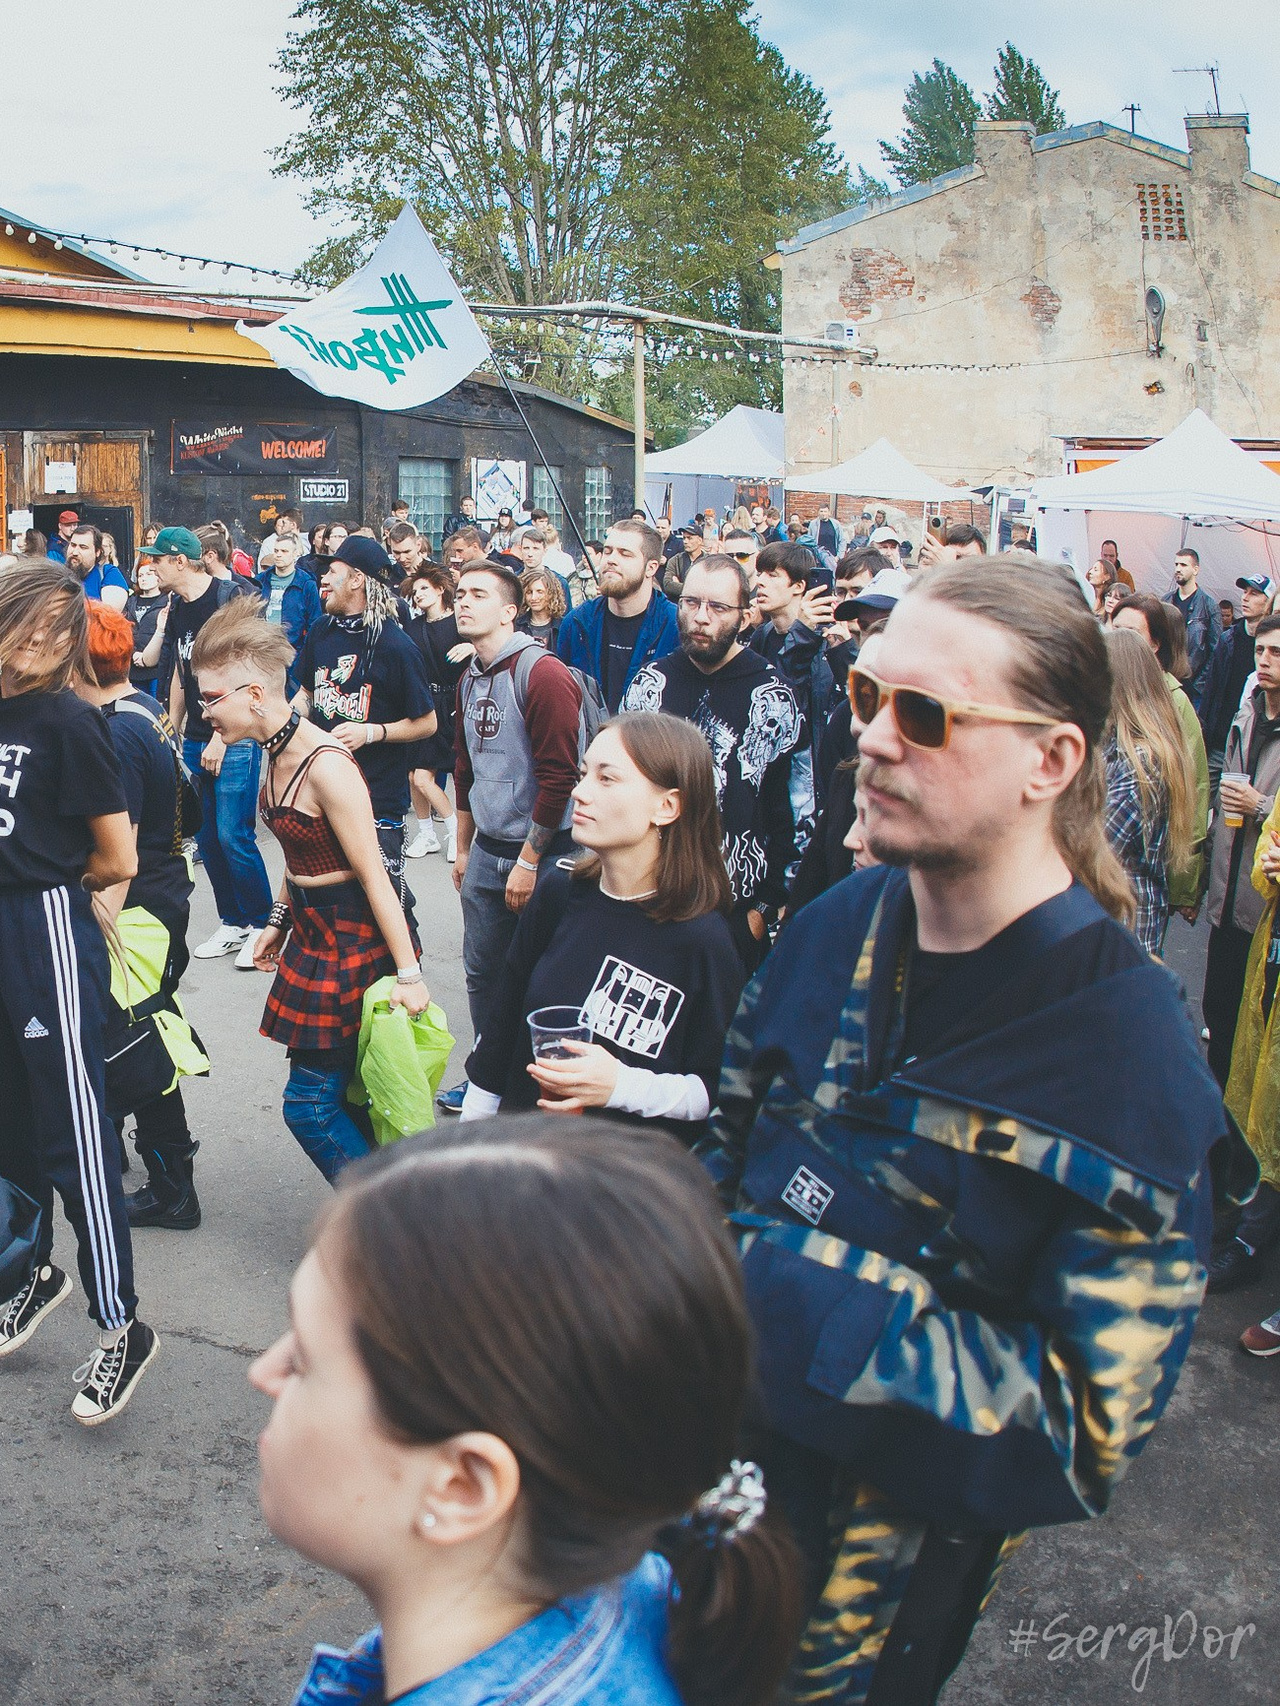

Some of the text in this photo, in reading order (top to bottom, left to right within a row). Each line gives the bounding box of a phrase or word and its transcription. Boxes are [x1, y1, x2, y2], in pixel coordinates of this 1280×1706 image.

[261, 439, 326, 460] WELCOME!
[303, 484, 345, 497] STUDIO 21
[24, 1029, 50, 1039] adidas
